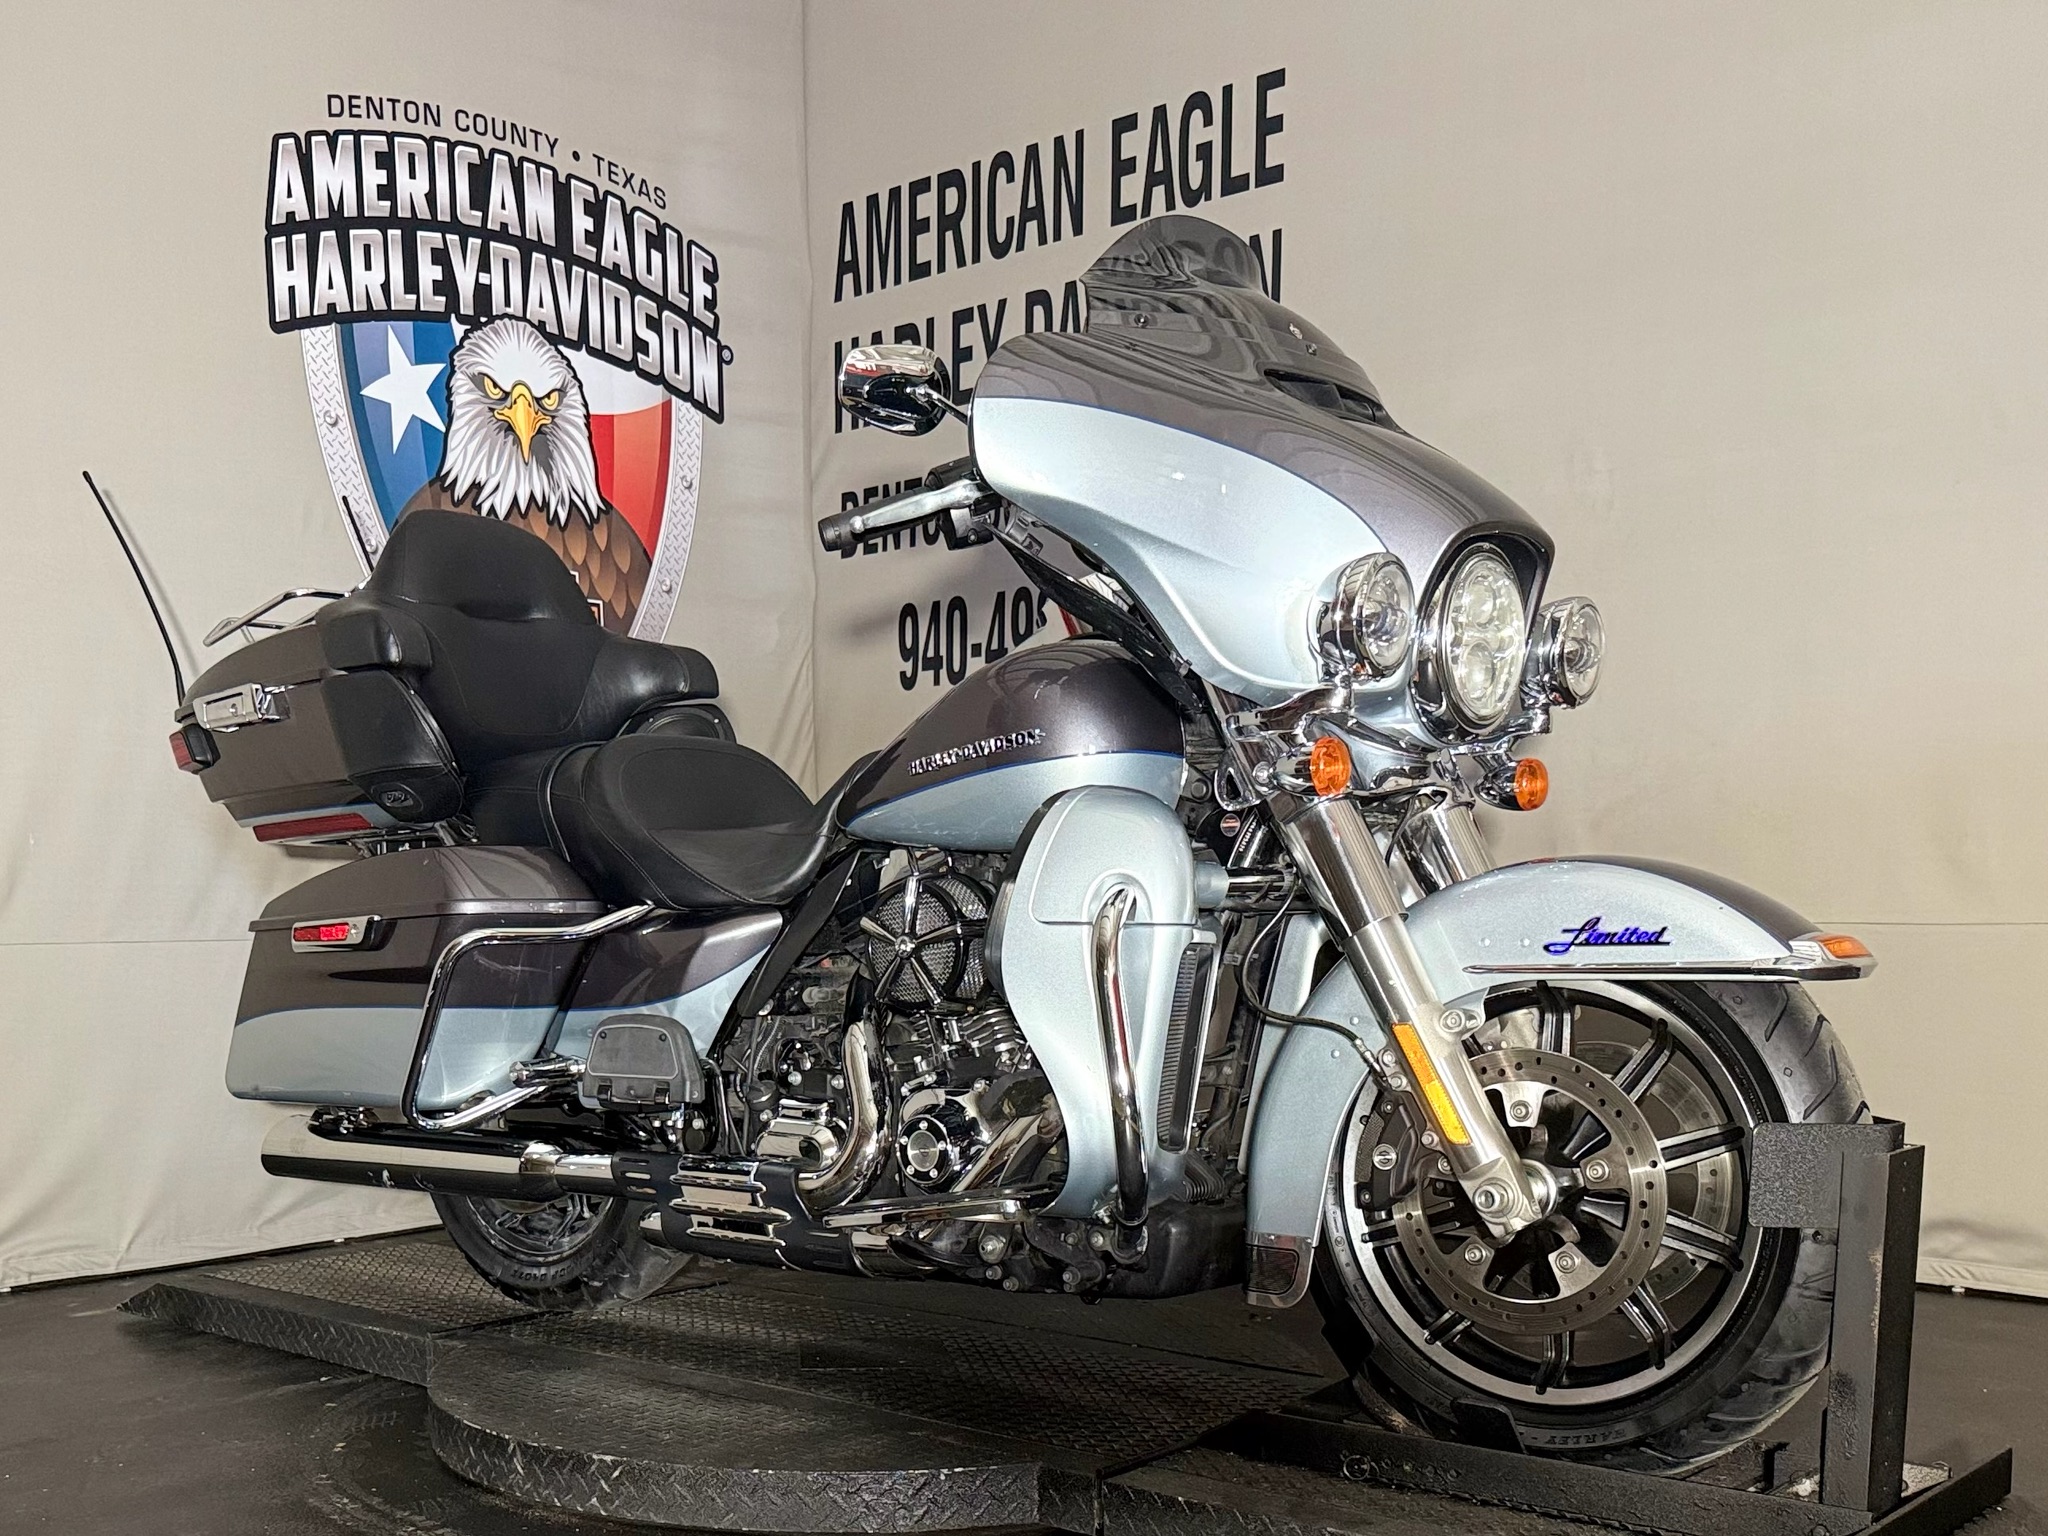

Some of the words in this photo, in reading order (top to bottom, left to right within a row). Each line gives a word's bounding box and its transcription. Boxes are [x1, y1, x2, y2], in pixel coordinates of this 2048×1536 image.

[271, 133, 557, 248] AMERICAN
[570, 178, 717, 326] EAGLE
[327, 94, 442, 128] DENTON
[454, 109, 559, 158] COUNTY
[592, 153, 668, 210] TEXAS
[834, 128, 1084, 304] AMERICAN
[1111, 67, 1286, 228] EAGLE
[270, 229, 720, 412] HARLEY-DAVIDSON
[834, 298, 1008, 434] HEY
[1543, 916, 1673, 955] Limited
